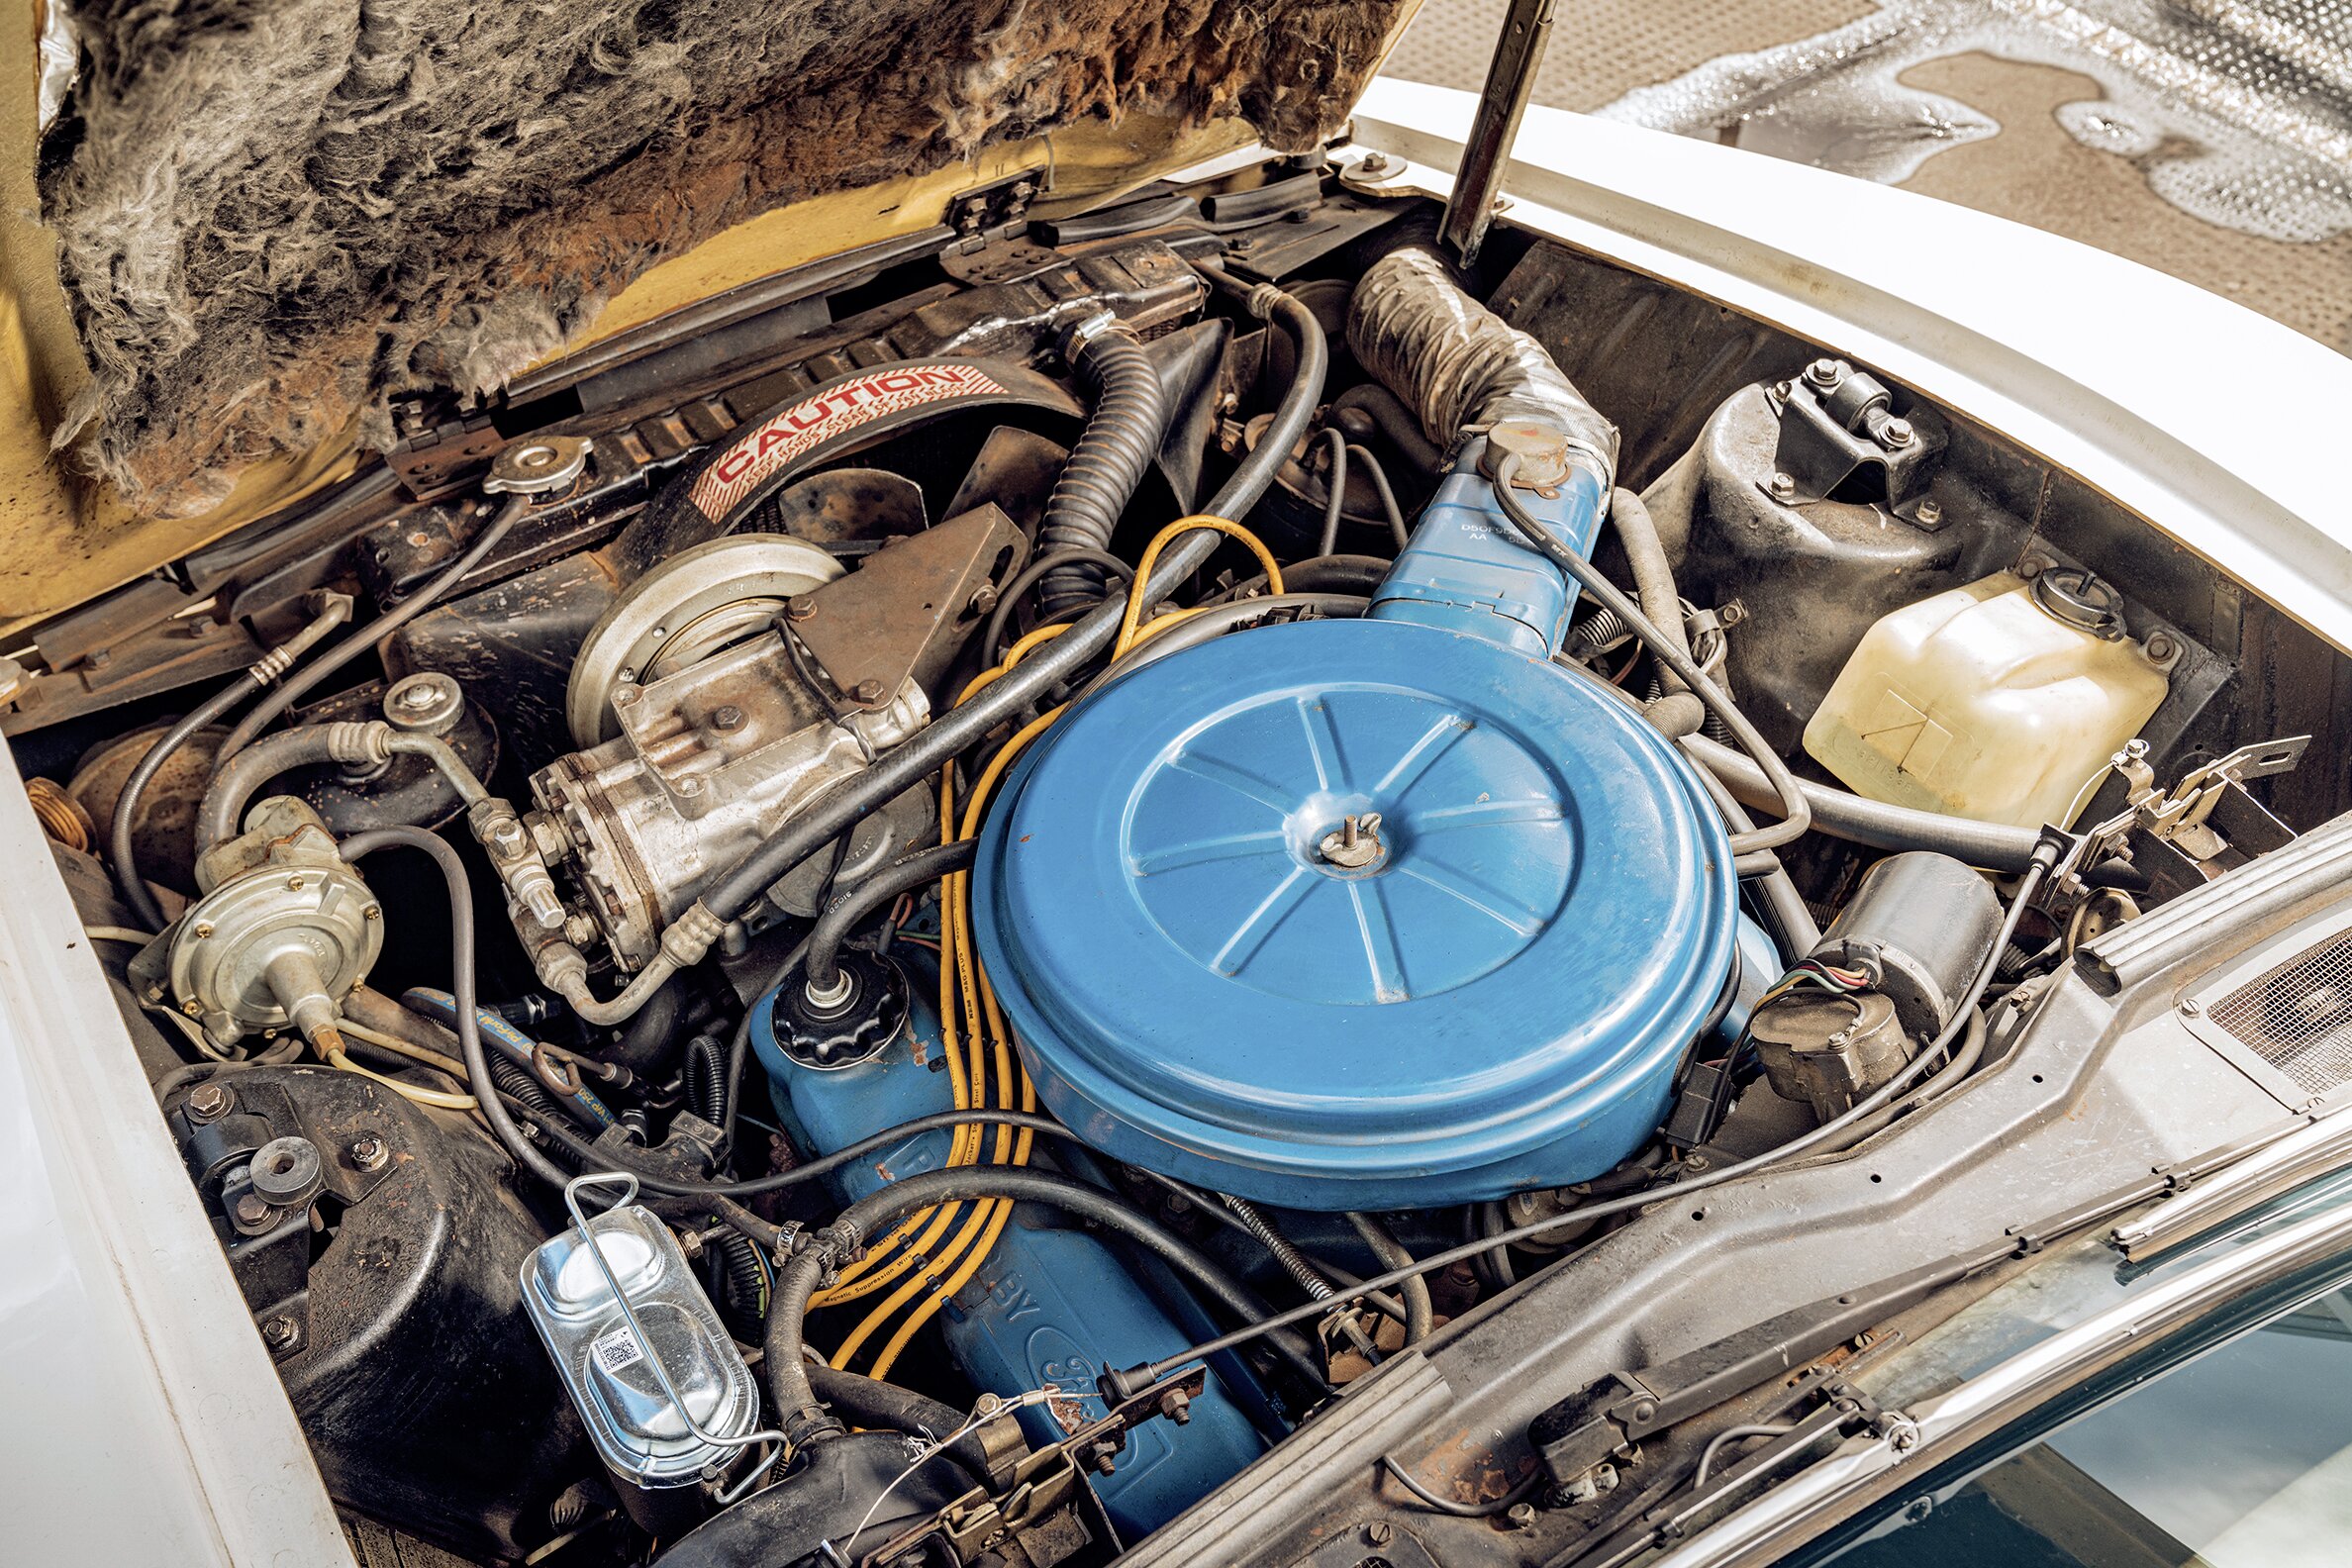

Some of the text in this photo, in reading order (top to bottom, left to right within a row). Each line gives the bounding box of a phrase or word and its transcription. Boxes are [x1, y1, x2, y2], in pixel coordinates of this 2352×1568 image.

[717, 370, 966, 484] CAUTION
[745, 459, 774, 484] KEEP
[778, 432, 821, 457] HANDS
[826, 410, 868, 431] CLEAR
[874, 401, 890, 411] OF
[896, 393, 922, 404] FAN
[1469, 532, 1488, 540] AA
[577, 1086, 594, 1103] 250
[824, 1291, 851, 1302] Magnetic
[854, 1267, 894, 1294] Suppression
[897, 1252, 912, 1268] Wire
[990, 1271, 1040, 1323] BY
